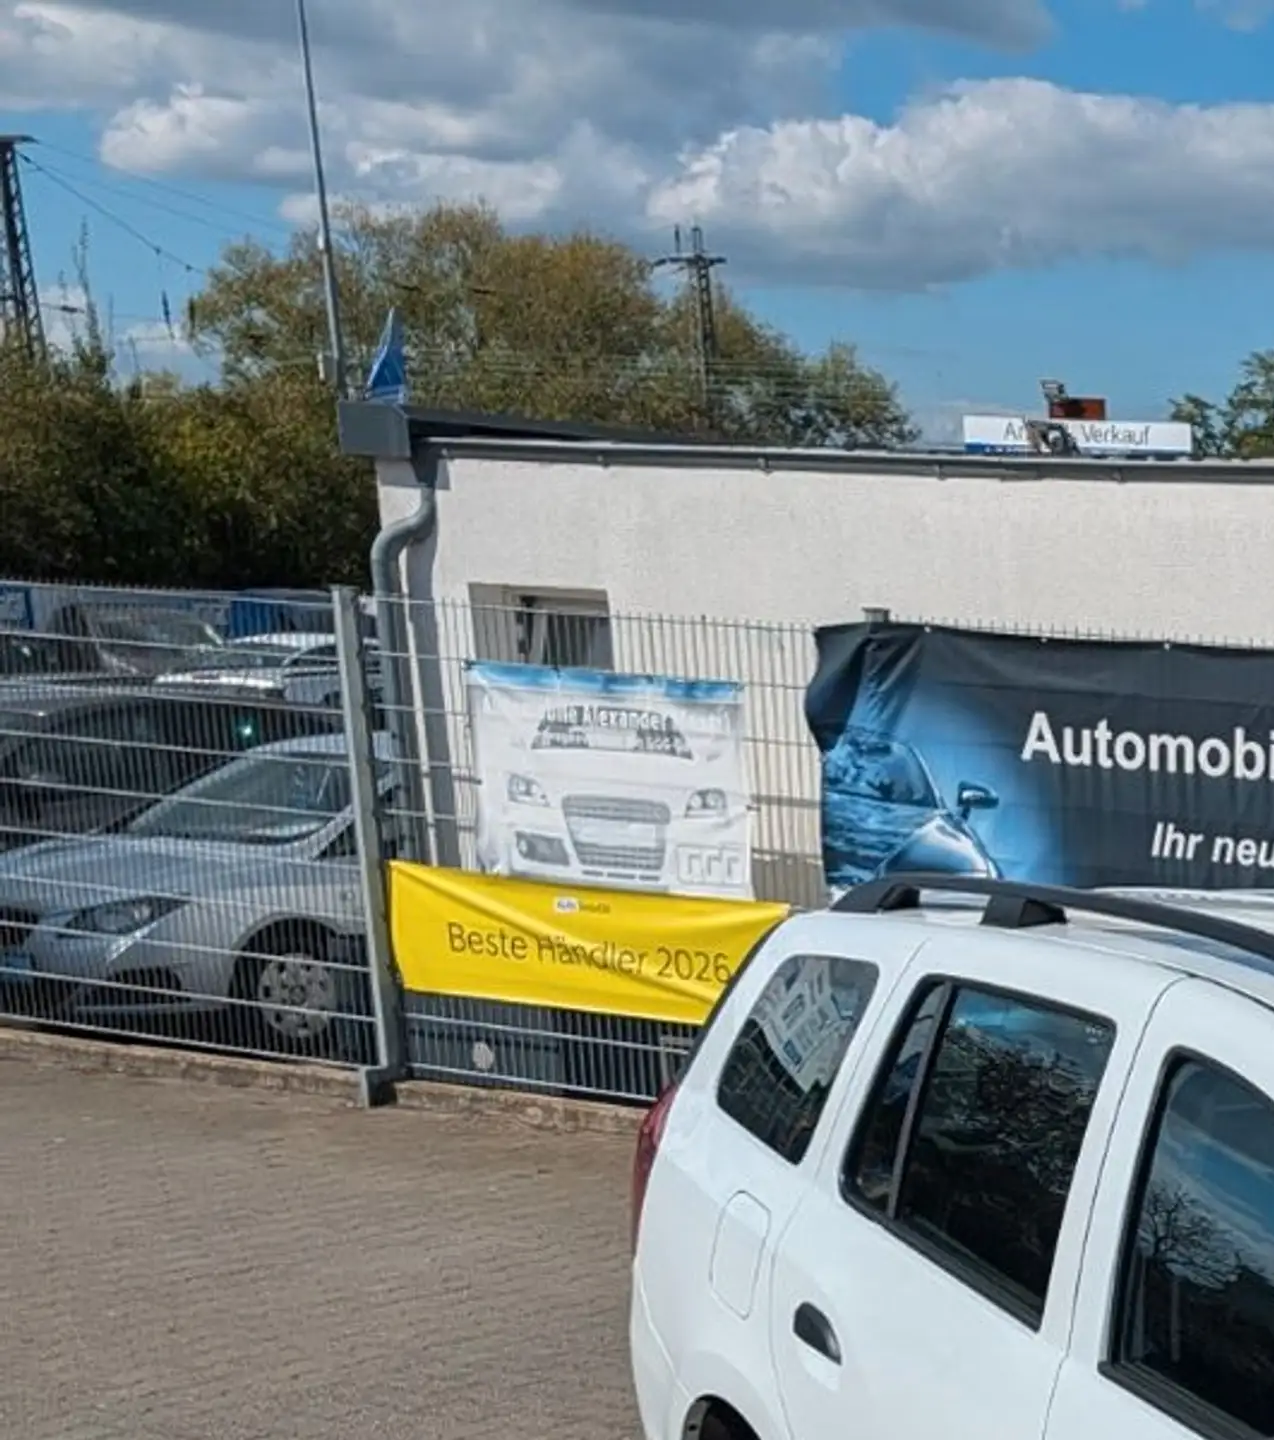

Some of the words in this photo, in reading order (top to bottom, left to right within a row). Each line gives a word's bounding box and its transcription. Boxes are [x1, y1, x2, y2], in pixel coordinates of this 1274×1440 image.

[1081, 424, 1150, 446] Verkauf
[1151, 822, 1204, 861] Ihr
[448, 922, 530, 961] Beste
[536, 935, 649, 977] Händler
[656, 948, 731, 986] 2026
